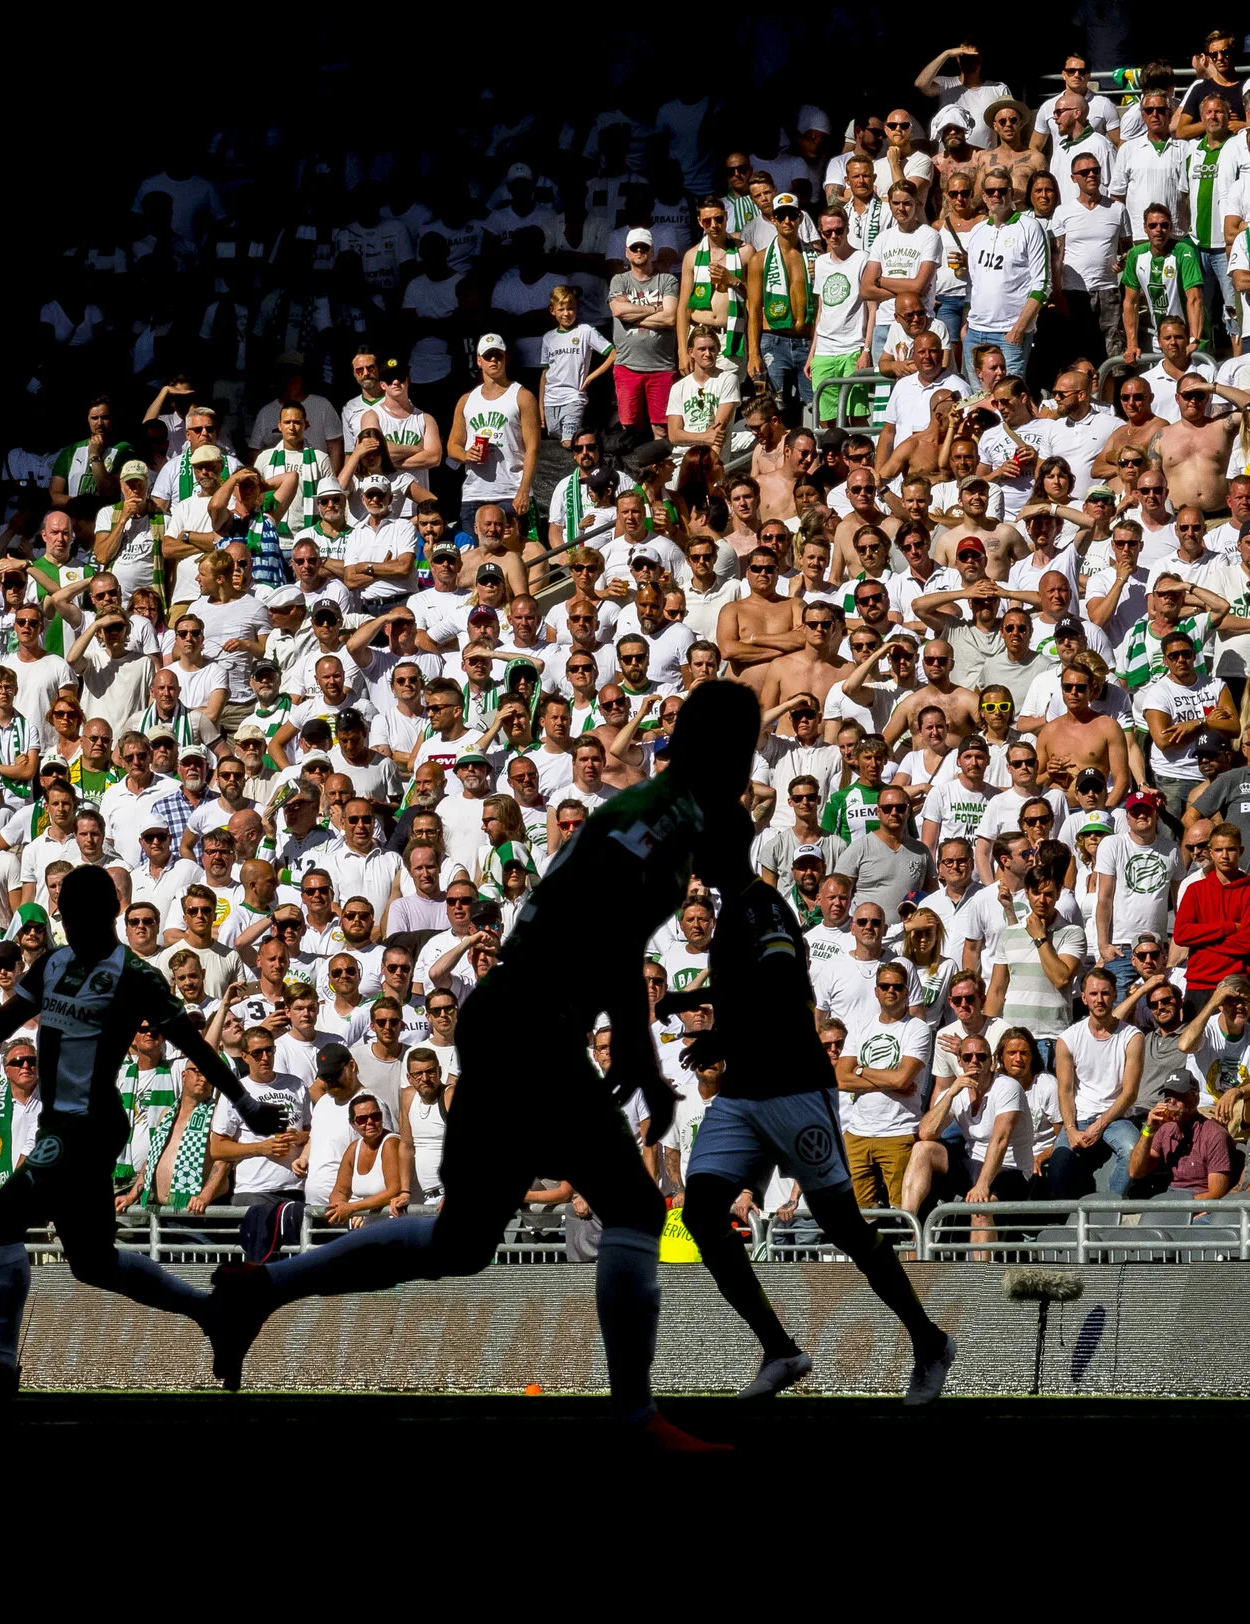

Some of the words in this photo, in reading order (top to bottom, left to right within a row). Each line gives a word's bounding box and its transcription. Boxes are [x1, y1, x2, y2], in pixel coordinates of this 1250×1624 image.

[650, 215, 690, 225] ERBALIFE
[469, 411, 509, 432] BAJEN
[493, 432, 504, 440] 97
[1174, 691, 1215, 708] STILL
[847, 807, 878, 820] SIEM
[42, 996, 95, 1021] OBMAN
[406, 1021, 429, 1032] ALIFE
